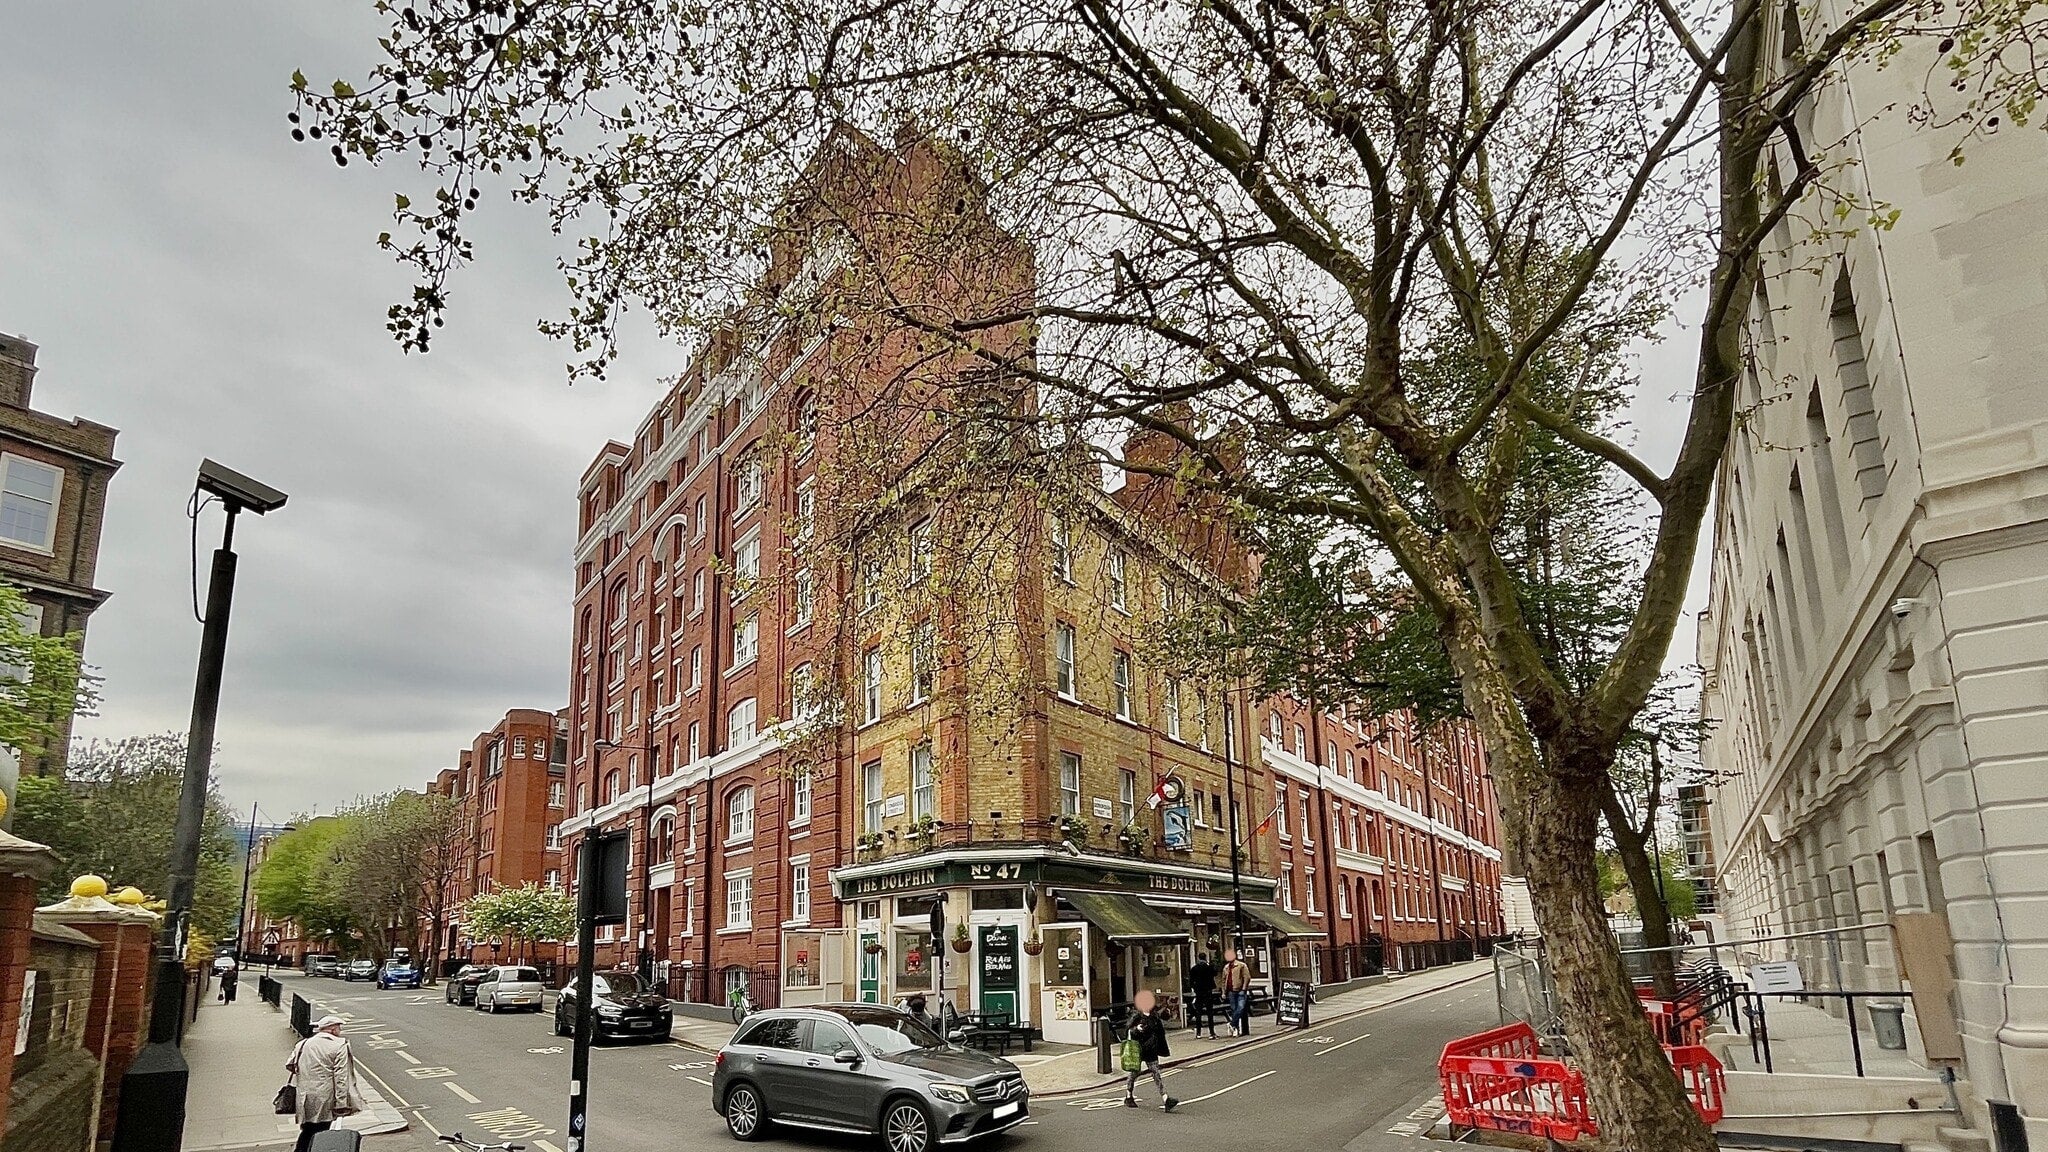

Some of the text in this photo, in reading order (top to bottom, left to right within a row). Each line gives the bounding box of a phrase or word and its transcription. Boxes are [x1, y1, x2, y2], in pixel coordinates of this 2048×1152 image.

[996, 864, 1021, 879] 47
[856, 868, 935, 894] THE DOLPHIN
[1149, 875, 1210, 893] THE DOLPHIN
